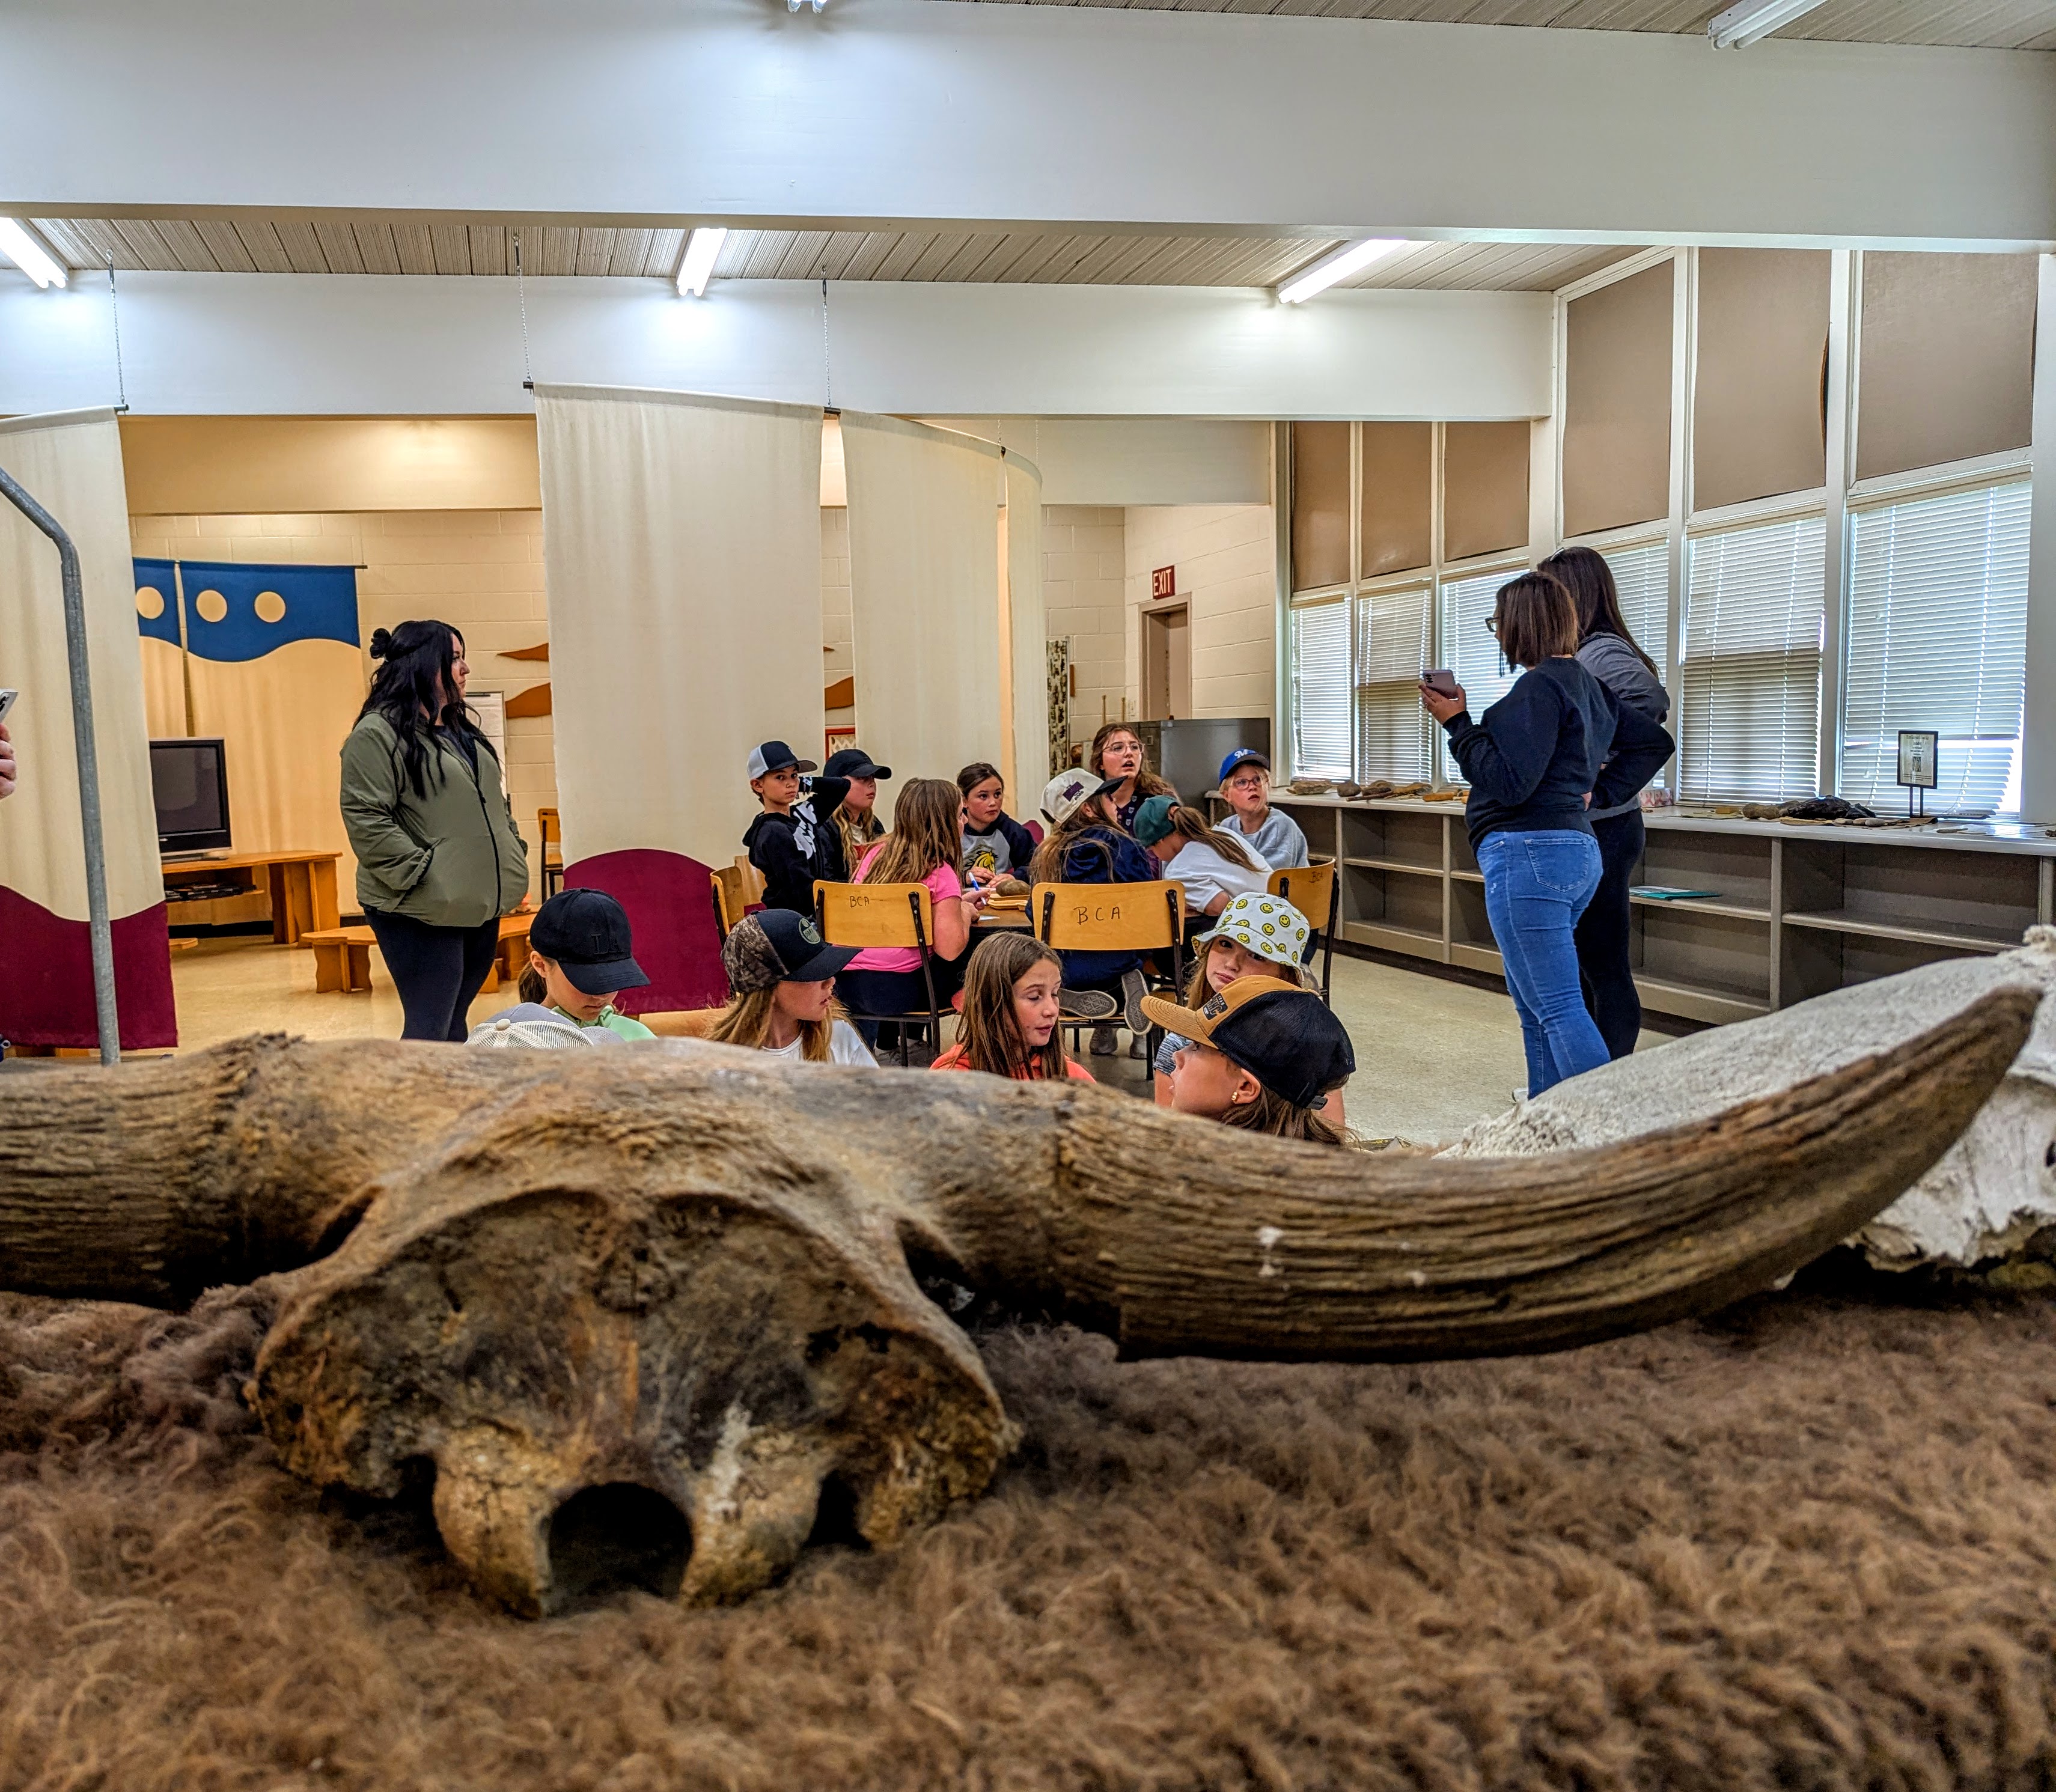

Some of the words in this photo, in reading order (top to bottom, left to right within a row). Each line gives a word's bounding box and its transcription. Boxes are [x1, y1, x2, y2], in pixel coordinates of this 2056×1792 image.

[1153, 568, 1171, 596] EXIT
[849, 895, 870, 908] BCA
[1073, 906, 1120, 925] BCA
